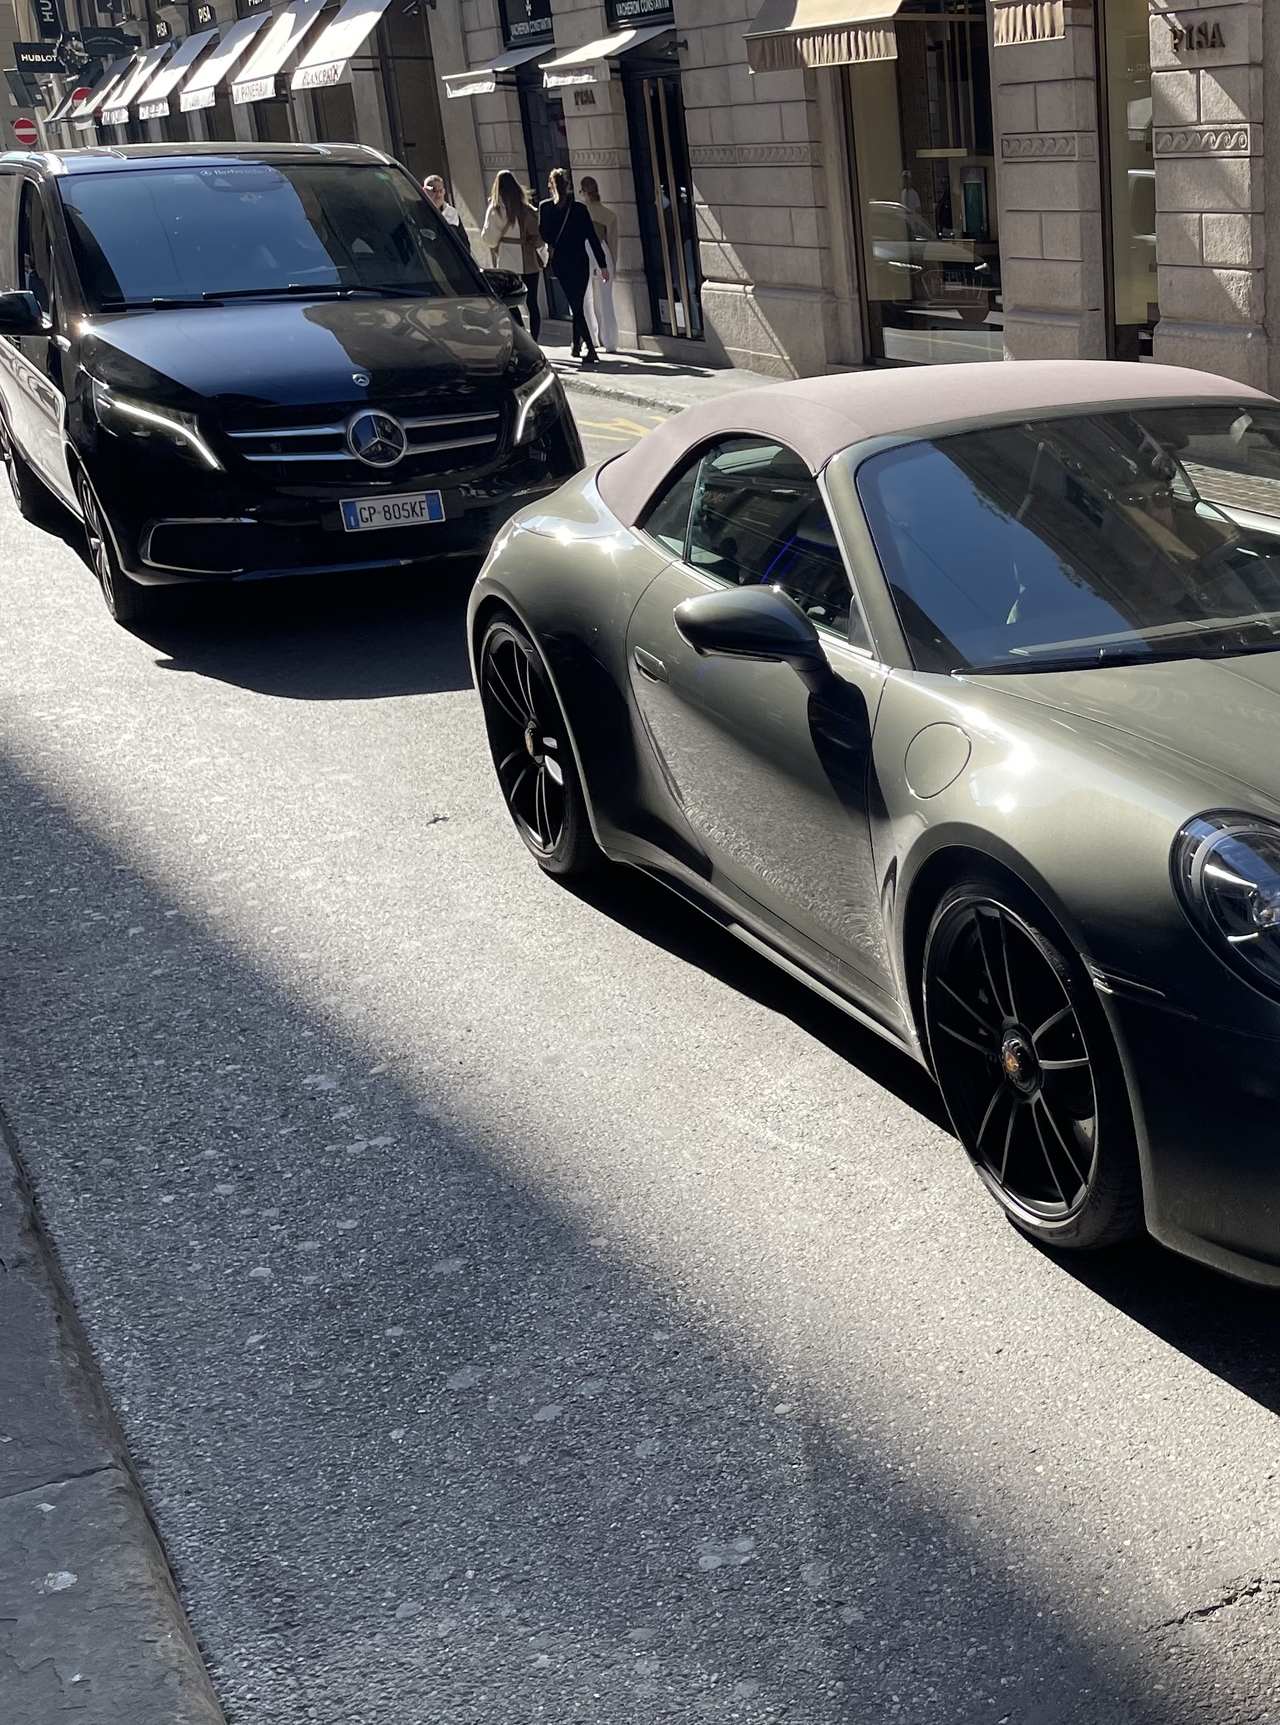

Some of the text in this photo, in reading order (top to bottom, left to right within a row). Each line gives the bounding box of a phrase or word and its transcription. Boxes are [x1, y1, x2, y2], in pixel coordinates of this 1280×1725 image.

[198, 5, 212, 23] PISA
[615, 0, 670, 17] VACHERON CONSTANTIN
[156, 21, 168, 37] PISA
[1169, 20, 1226, 52] PISA
[360, 507, 376, 523] GP
[382, 501, 426, 521] 805KF
